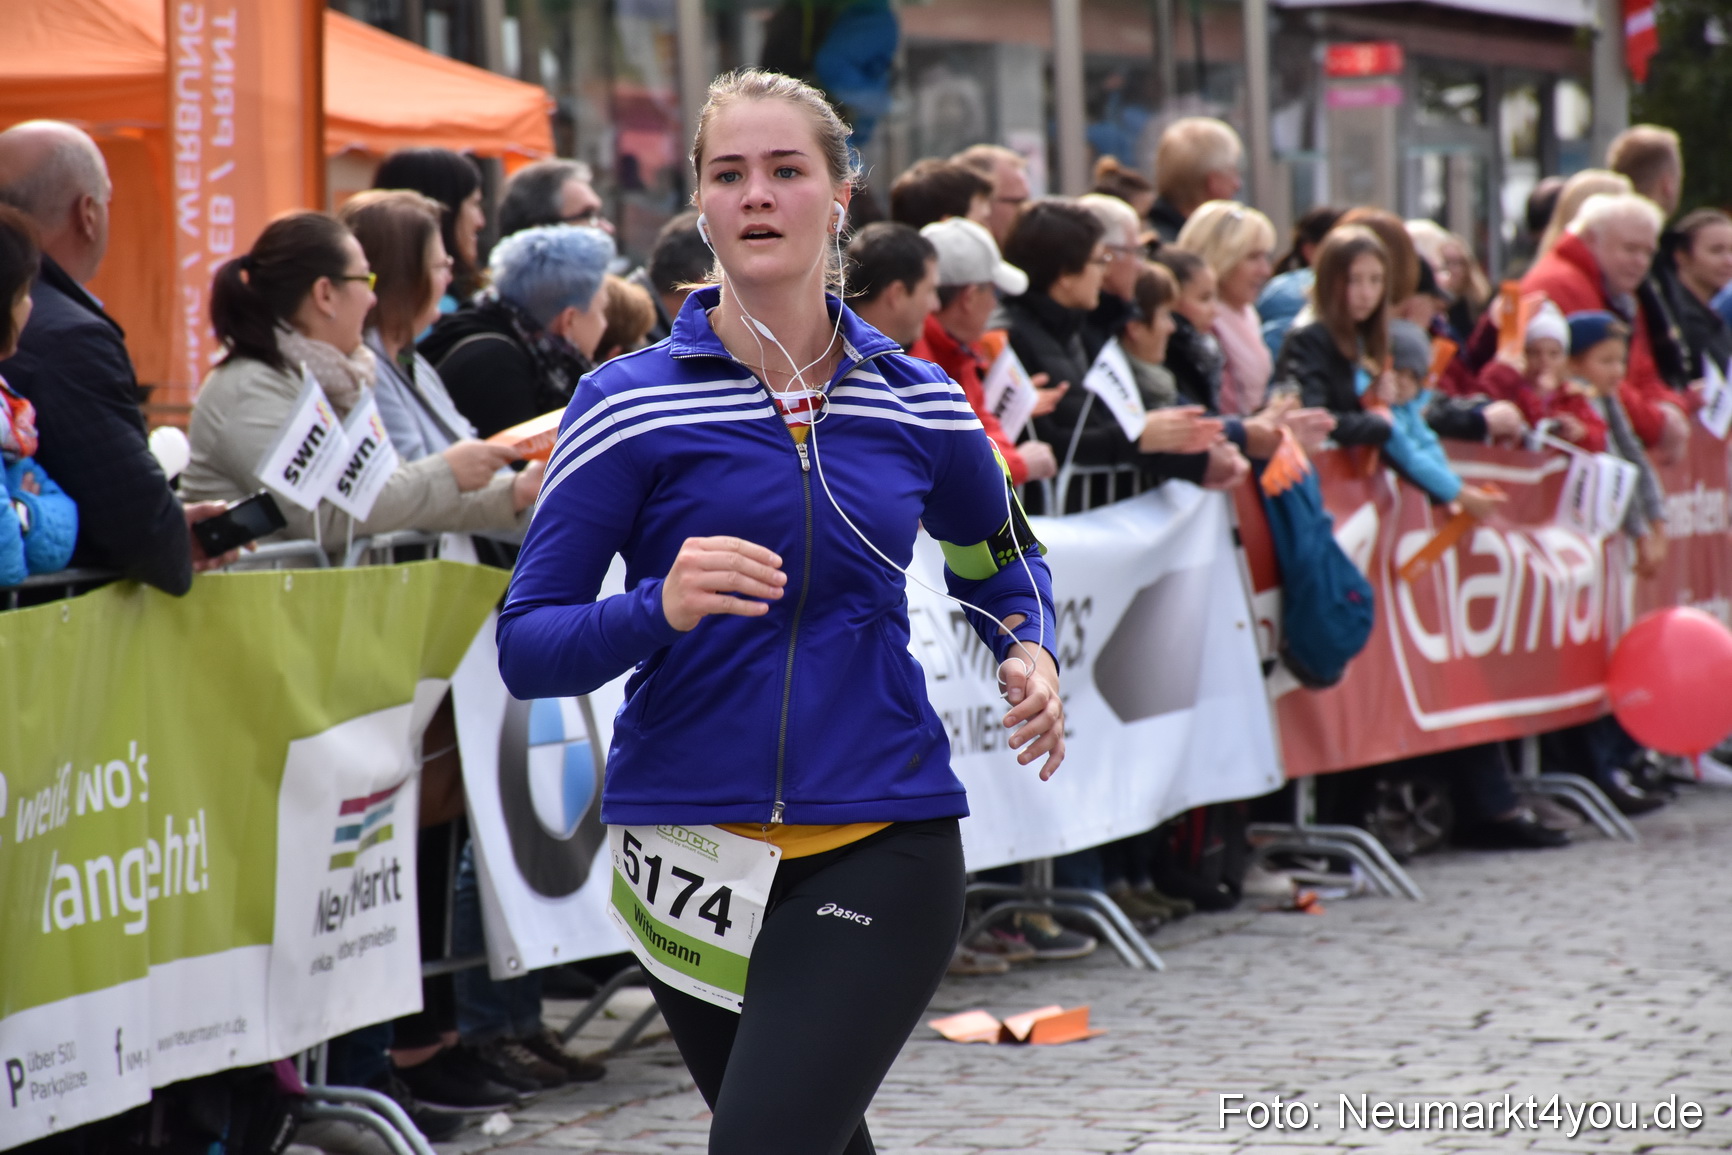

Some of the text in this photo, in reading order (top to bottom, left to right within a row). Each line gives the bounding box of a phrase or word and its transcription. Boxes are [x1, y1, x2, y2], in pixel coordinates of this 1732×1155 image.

[283, 423, 326, 486] swn
[336, 436, 377, 499] swn
[657, 824, 720, 858] BOCK
[623, 829, 732, 937] 5174
[634, 903, 701, 967] Wittmann
[833, 907, 873, 926] asics
[6, 1058, 25, 1108] P
[27, 1051, 56, 1073] über
